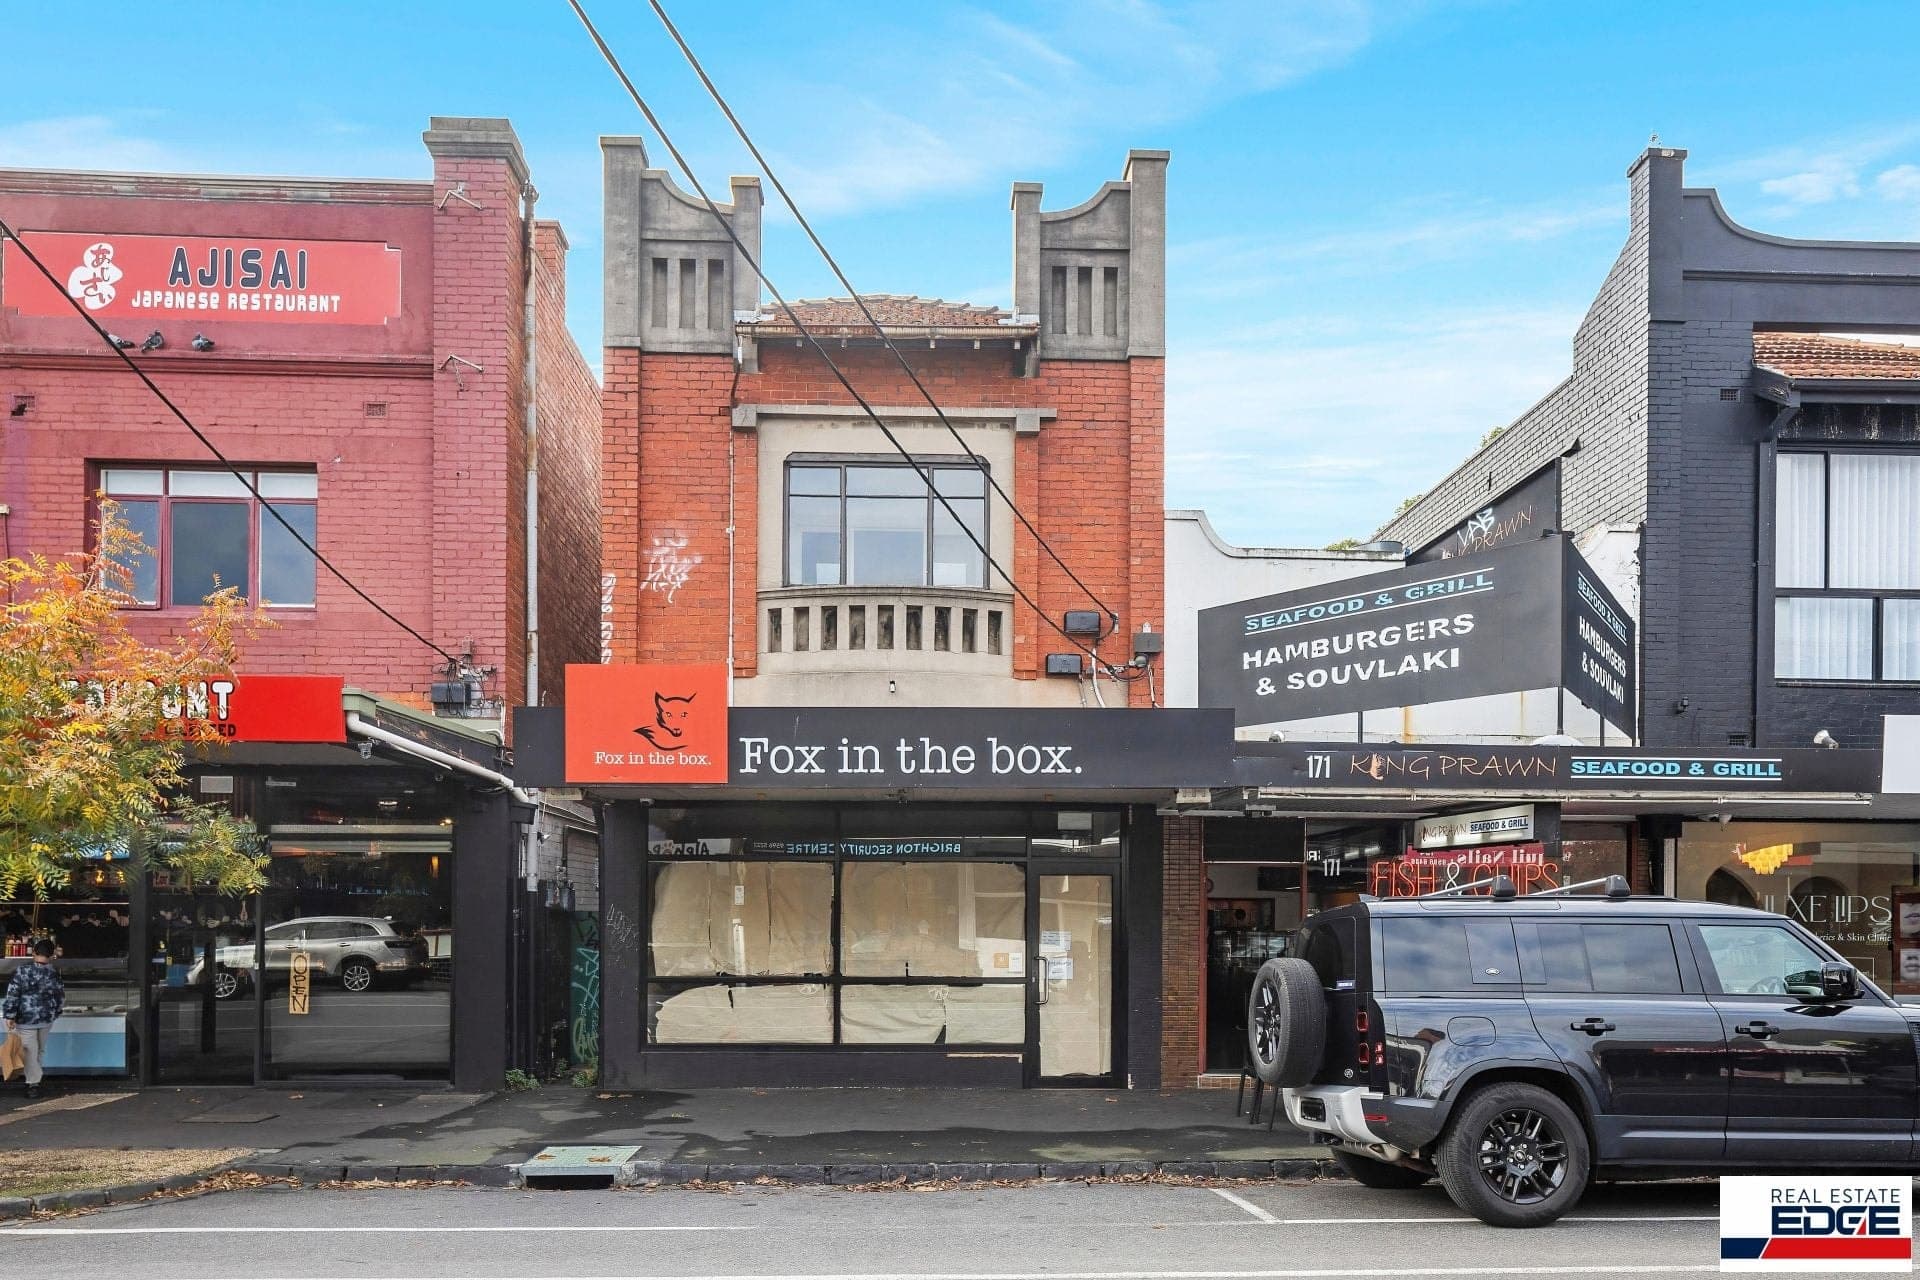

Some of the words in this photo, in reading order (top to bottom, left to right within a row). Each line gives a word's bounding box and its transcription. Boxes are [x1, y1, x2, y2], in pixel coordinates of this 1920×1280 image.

[168, 246, 307, 289] AJISAI
[1246, 598, 1364, 631] SEAFOOD
[1375, 593, 1394, 606] &
[1405, 574, 1493, 600] GRILL
[1578, 576, 1606, 617] SEAFOOD
[1612, 616, 1627, 641] GRILL
[1242, 613, 1475, 670] HAMBURGERS
[1579, 615, 1627, 678] HAMBURGERS
[1255, 677, 1276, 696] &
[1286, 647, 1460, 690] SOUVLAKI
[1581, 651, 1588, 674] &
[1589, 658, 1624, 704] SOUVLAKI
[594, 751, 625, 765] Fox
[629, 751, 644, 765] in
[648, 751, 675, 765] the
[678, 751, 712, 765] box.
[738, 737, 826, 774] Fox
[838, 737, 884, 774] in
[896, 737, 976, 774] the
[987, 737, 1082, 774] box.
[1306, 755, 1332, 779] 171
[1439, 755, 1557, 777] PRAWN
[1571, 761, 1681, 776] SEAFOOD
[1689, 761, 1705, 776] &
[1713, 762, 1782, 776] GRILL
[1470, 820, 1500, 833] SEAFOOD
[1502, 820, 1506, 829] &
[1508, 818, 1529, 828] GRILL
[1322, 858, 1341, 877] 171
[1373, 861, 1435, 897] FISH
[1445, 861, 1463, 896] &
[1847, 931, 1865, 941] Skin
[292, 955, 308, 1012] OPEN
